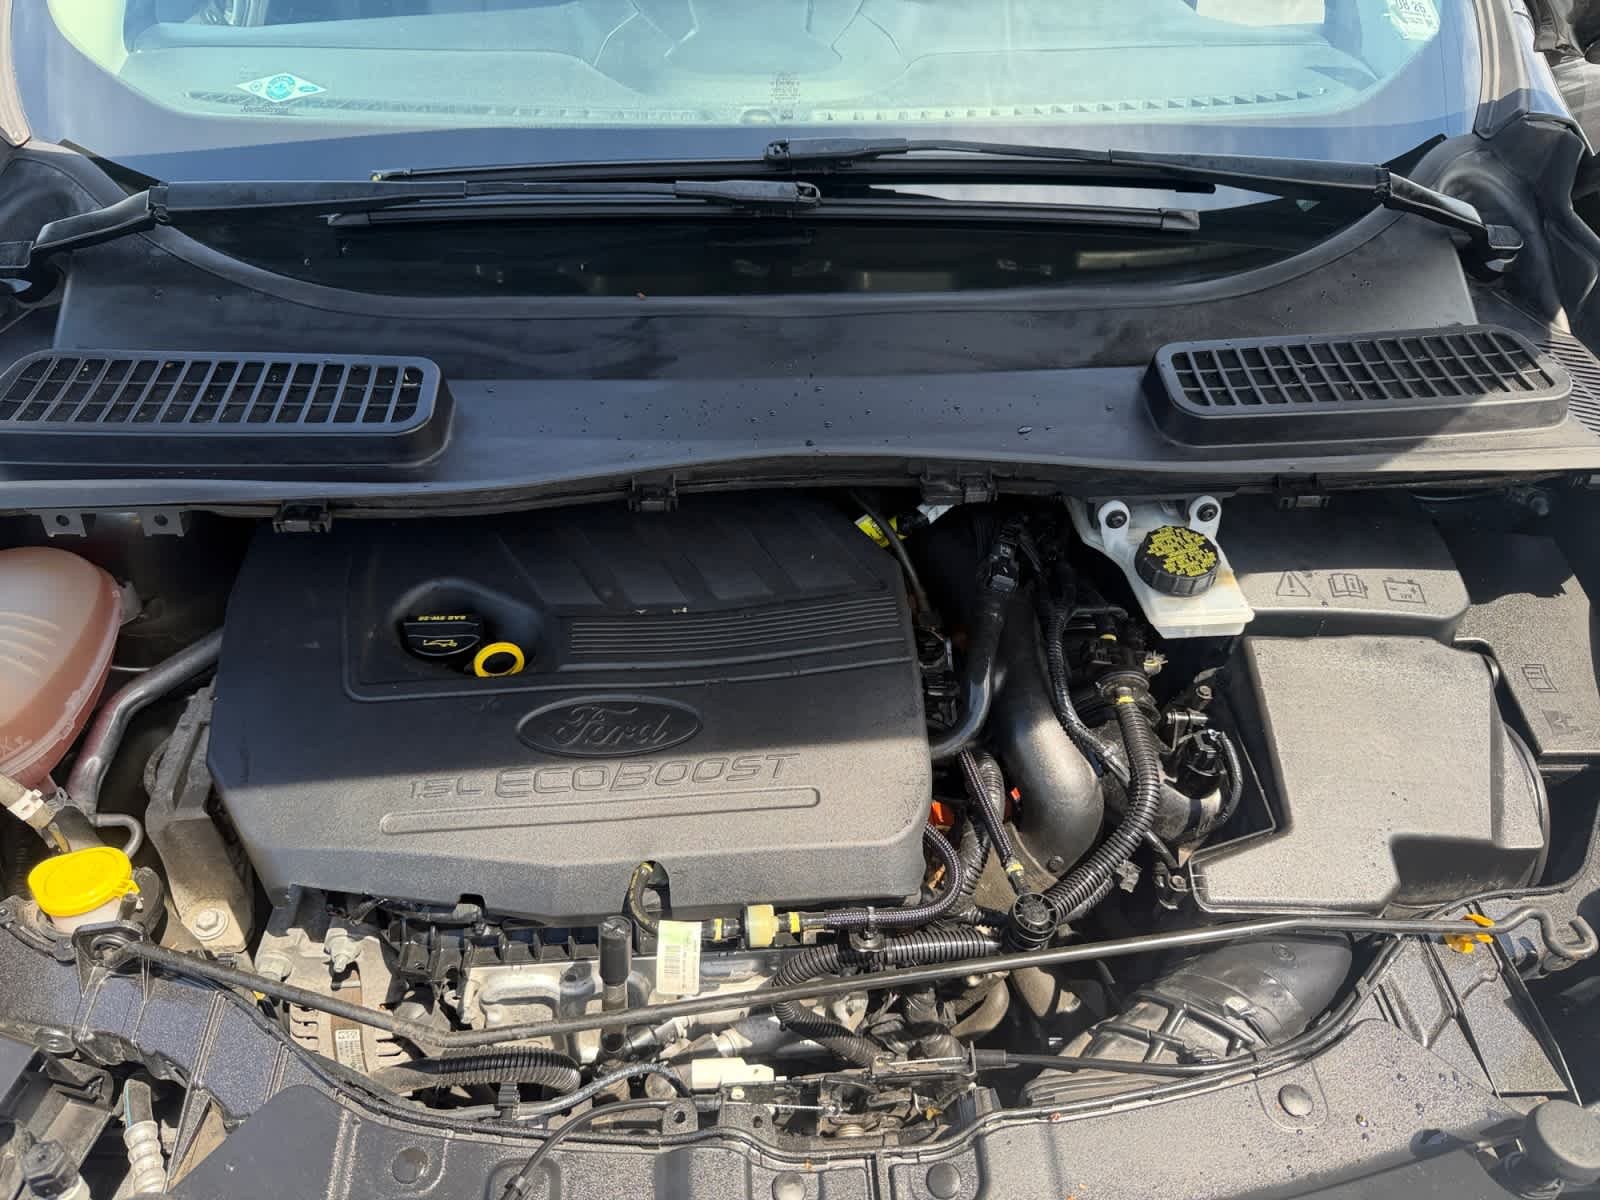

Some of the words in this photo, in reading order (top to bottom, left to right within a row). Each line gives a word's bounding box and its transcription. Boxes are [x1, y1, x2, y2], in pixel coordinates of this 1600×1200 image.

[552, 704, 672, 745] Ford
[410, 775, 485, 799] 1.5L
[495, 752, 801, 798] ECOBOOST
